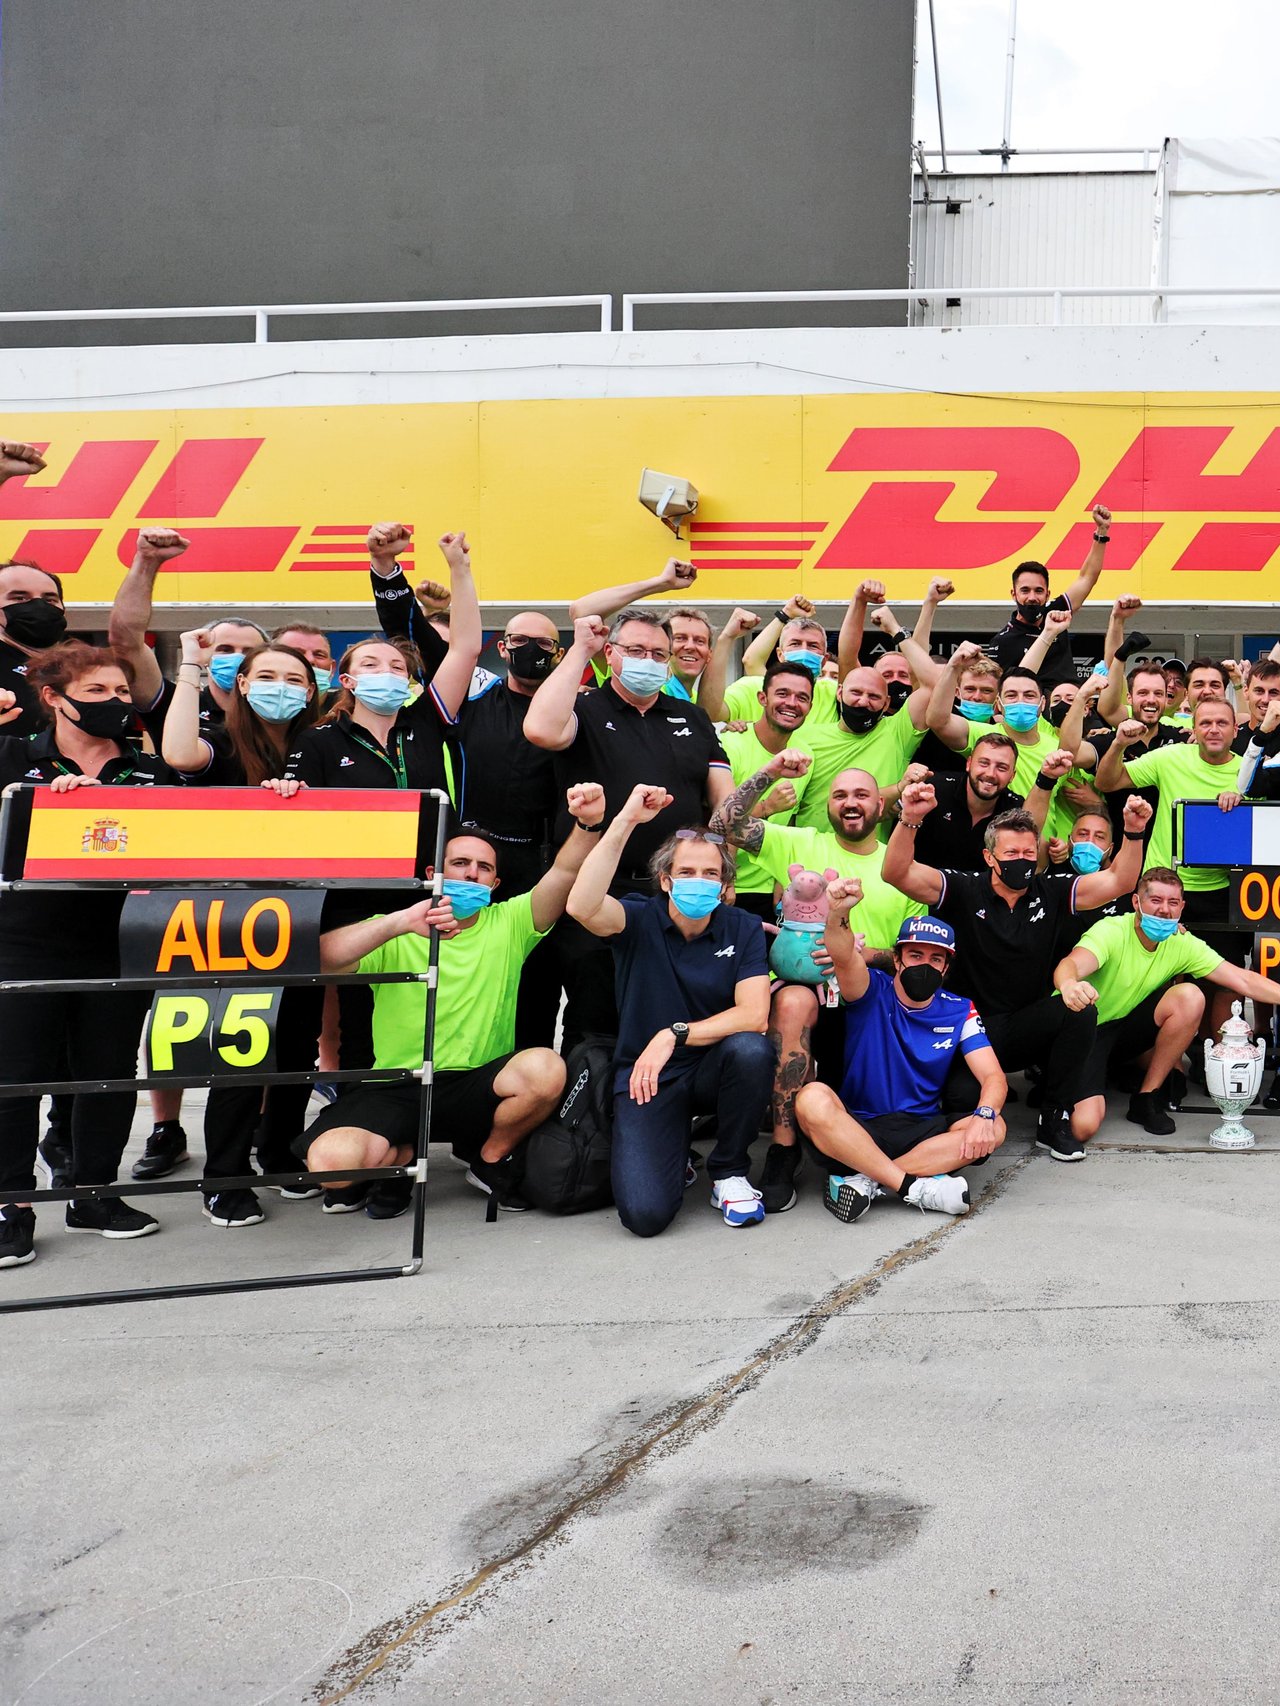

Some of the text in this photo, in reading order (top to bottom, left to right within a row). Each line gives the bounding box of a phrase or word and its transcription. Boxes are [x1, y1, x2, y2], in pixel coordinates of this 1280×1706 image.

[155, 897, 291, 972] ALO
[909, 920, 949, 938] kimoa
[1229, 1081, 1248, 1093] 1
